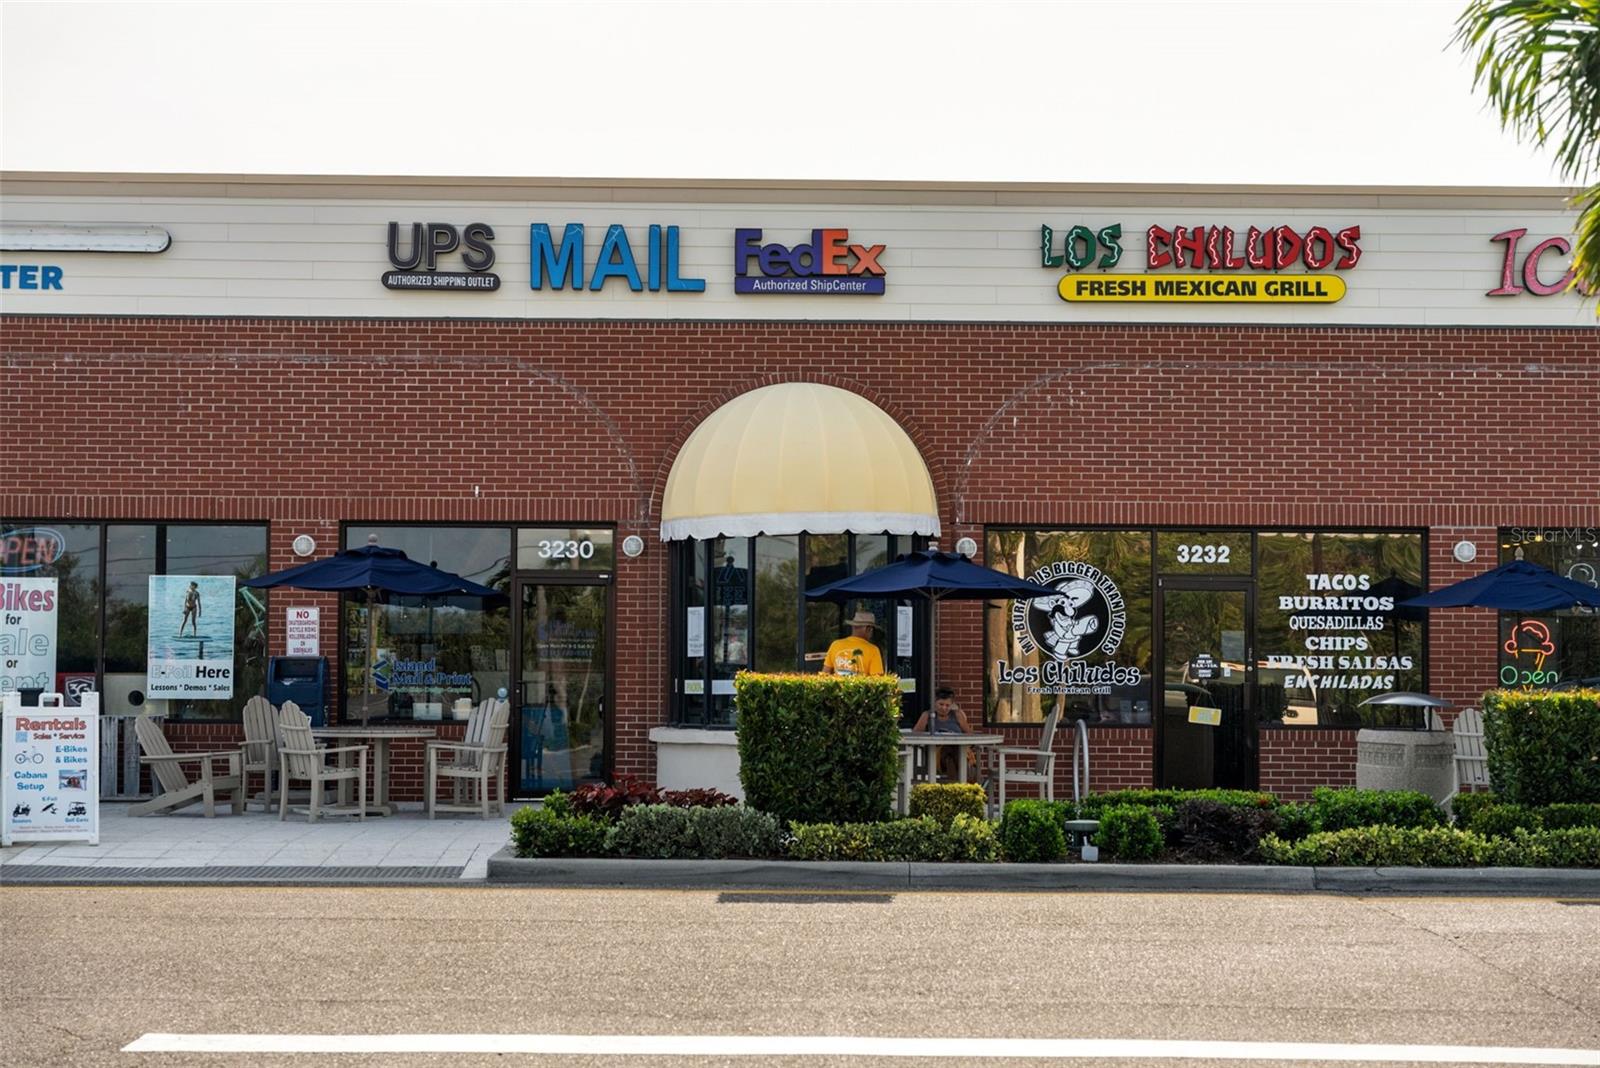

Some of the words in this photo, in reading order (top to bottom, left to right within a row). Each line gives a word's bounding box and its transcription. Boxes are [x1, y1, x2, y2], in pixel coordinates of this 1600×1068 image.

[387, 221, 496, 271] UPS
[735, 228, 887, 275] FedEx
[1040, 223, 1124, 269] LOS
[1147, 223, 1363, 270] CHILUDOS
[530, 223, 706, 291] MAIL
[0, 265, 63, 289] TER
[388, 275, 432, 286] AUTHORIZED
[433, 276, 466, 287] SHIPPING
[467, 277, 495, 288] OUTLET
[753, 279, 808, 290] Authorized
[810, 279, 866, 292] ShipCenter
[1076, 280, 1146, 296] FRESH
[1154, 280, 1257, 297] MEXICAN
[1264, 281, 1328, 297] GRILL
[538, 540, 594, 559] 3230
[1176, 544, 1230, 564] 3232
[1036, 565, 1052, 581] IS
[1052, 561, 1102, 584] BIGGER
[1306, 574, 1371, 591] TACOS
[1098, 574, 1124, 611] THAN
[1278, 596, 1395, 611] BURRITOS
[5, 613, 22, 625] for
[296, 611, 310, 619] NO
[1289, 615, 1384, 630] QUESADILLAS
[1102, 611, 1126, 656] YOURS
[1017, 635, 1035, 656] MY
[1305, 636, 1369, 651] CHIPS
[6, 659, 18, 668] or
[393, 657, 437, 672] Island
[1266, 655, 1335, 669] FRESH
[1338, 655, 1413, 670] SALSAS
[195, 665, 230, 679] Here
[392, 672, 424, 685] Mail
[437, 672, 473, 685] Print
[998, 660, 1039, 685] Los
[1042, 660, 1141, 686] Chiludos
[213, 684, 230, 692] Sales
[1283, 674, 1395, 689] ENCHILADAS
[1027, 686, 1052, 694] Fresh
[1053, 686, 1091, 694] Mexican
[1092, 686, 1111, 694] Grill
[15, 717, 87, 731] Rentals
[55, 745, 88, 753] E-Bikes
[14, 771, 48, 779] Cabana
[16, 782, 45, 792] Setup
